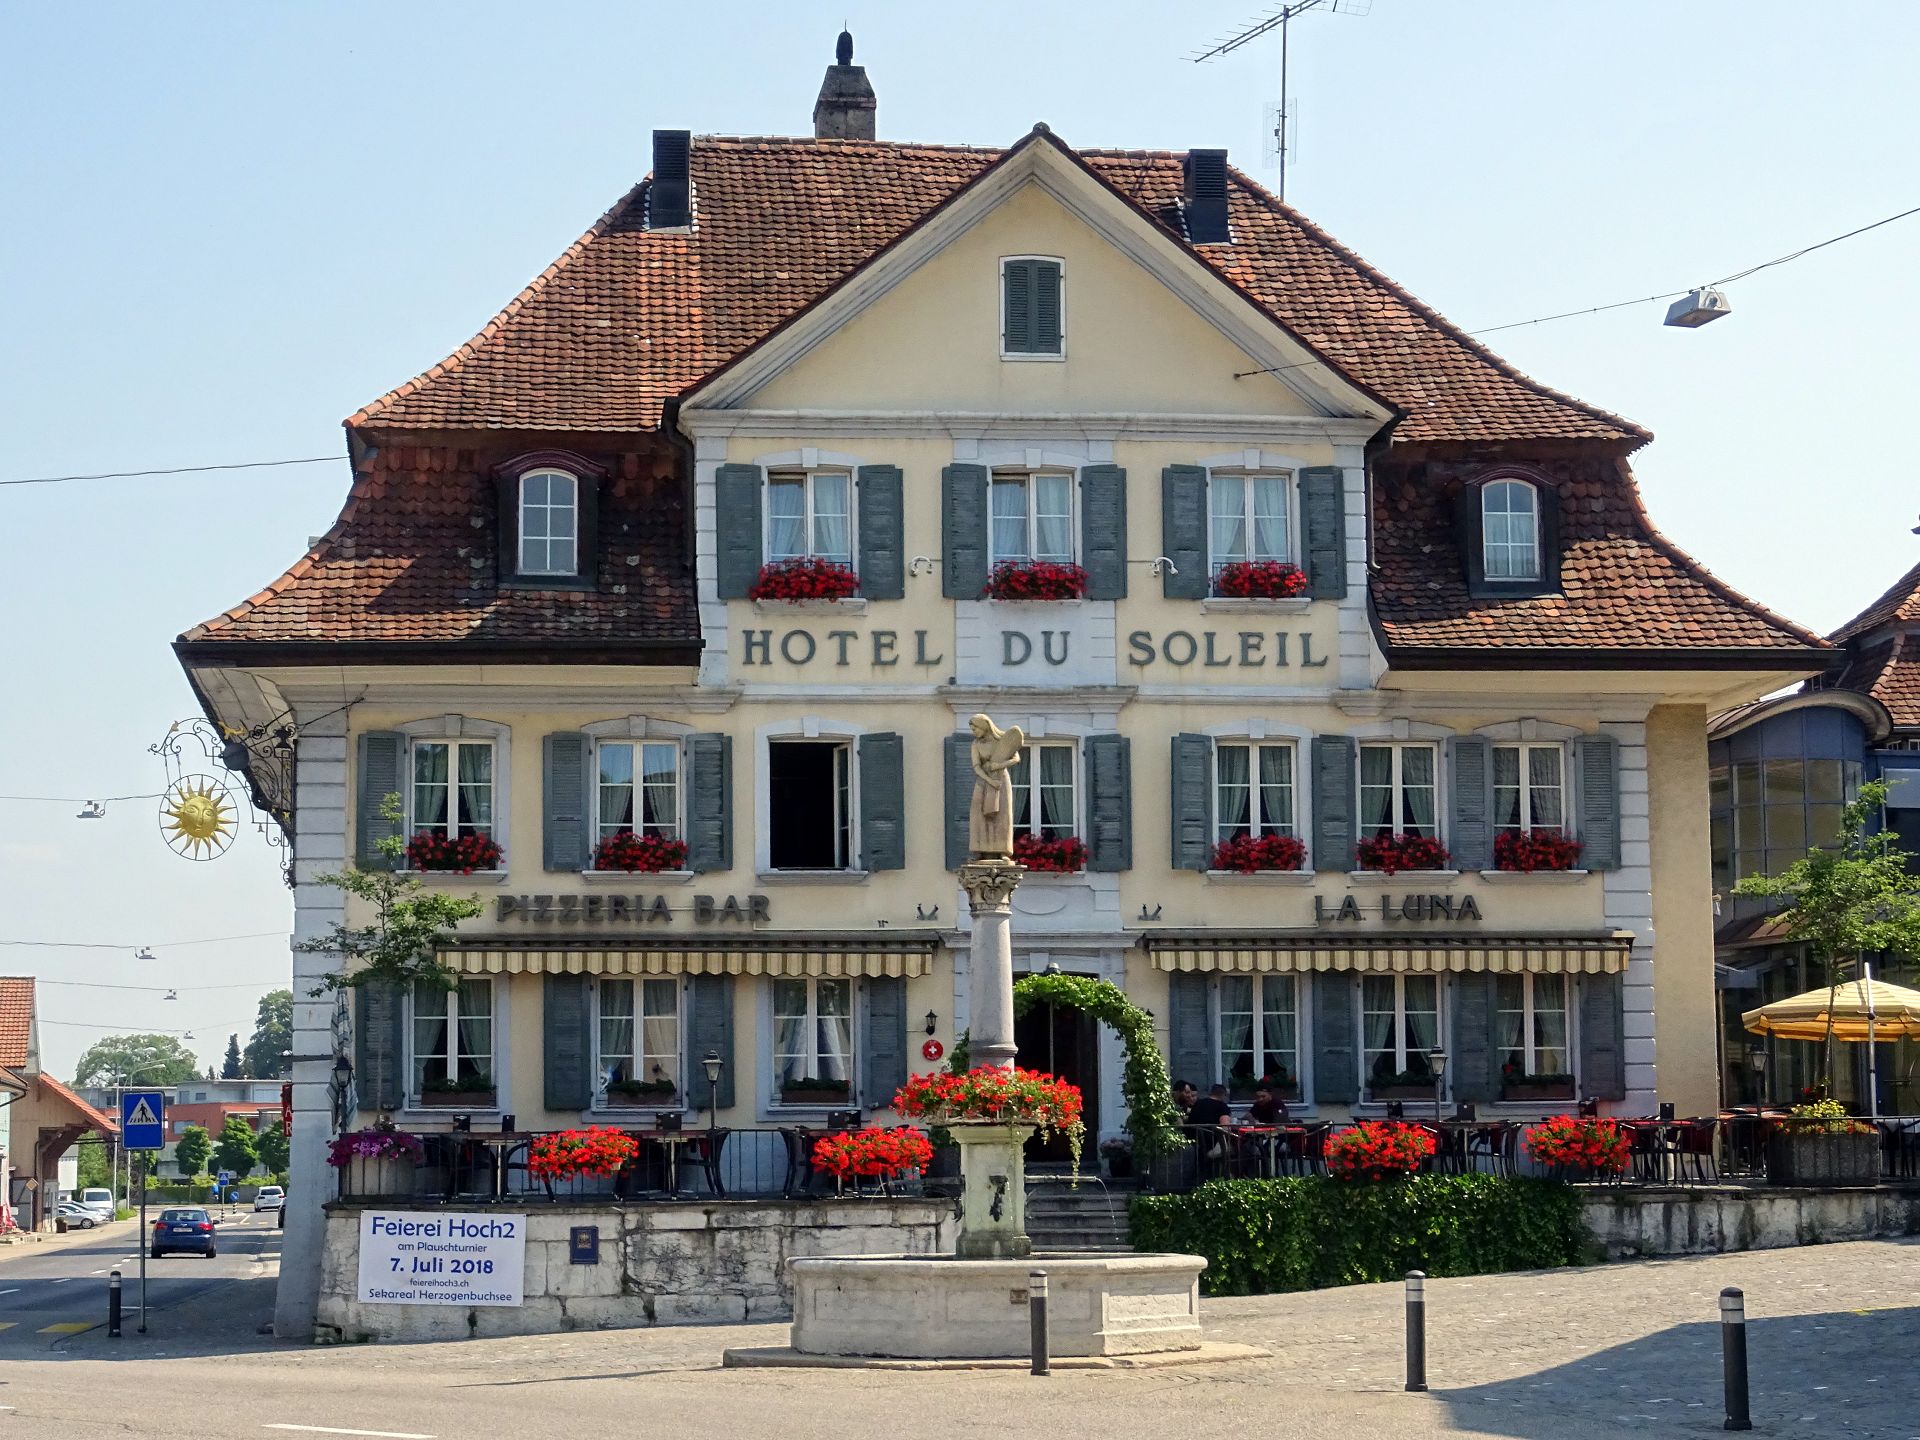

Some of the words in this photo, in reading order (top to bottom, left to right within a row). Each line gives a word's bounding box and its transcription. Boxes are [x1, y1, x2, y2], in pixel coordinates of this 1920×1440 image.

[742, 629, 943, 665] HOTEL
[1001, 630, 1071, 666] DU
[1129, 630, 1328, 667] SOLEIL
[496, 895, 672, 922] PIZZERIA
[694, 895, 771, 922] BAR
[1315, 895, 1362, 921] LA
[1381, 895, 1482, 921] LUNA
[372, 1216, 441, 1237] Feierei
[448, 1218, 515, 1239] Hoch2
[397, 1243, 415, 1251] am
[417, 1241, 488, 1253] Plauschturnier
[390, 1257, 405, 1272] 7.
[411, 1256, 443, 1273] Juli
[450, 1259, 494, 1274] 2018
[409, 1278, 470, 1288] feiereihoch3.ch
[369, 1288, 416, 1299] Sekareal
[419, 1290, 512, 1302] Herzogenbuchsee
